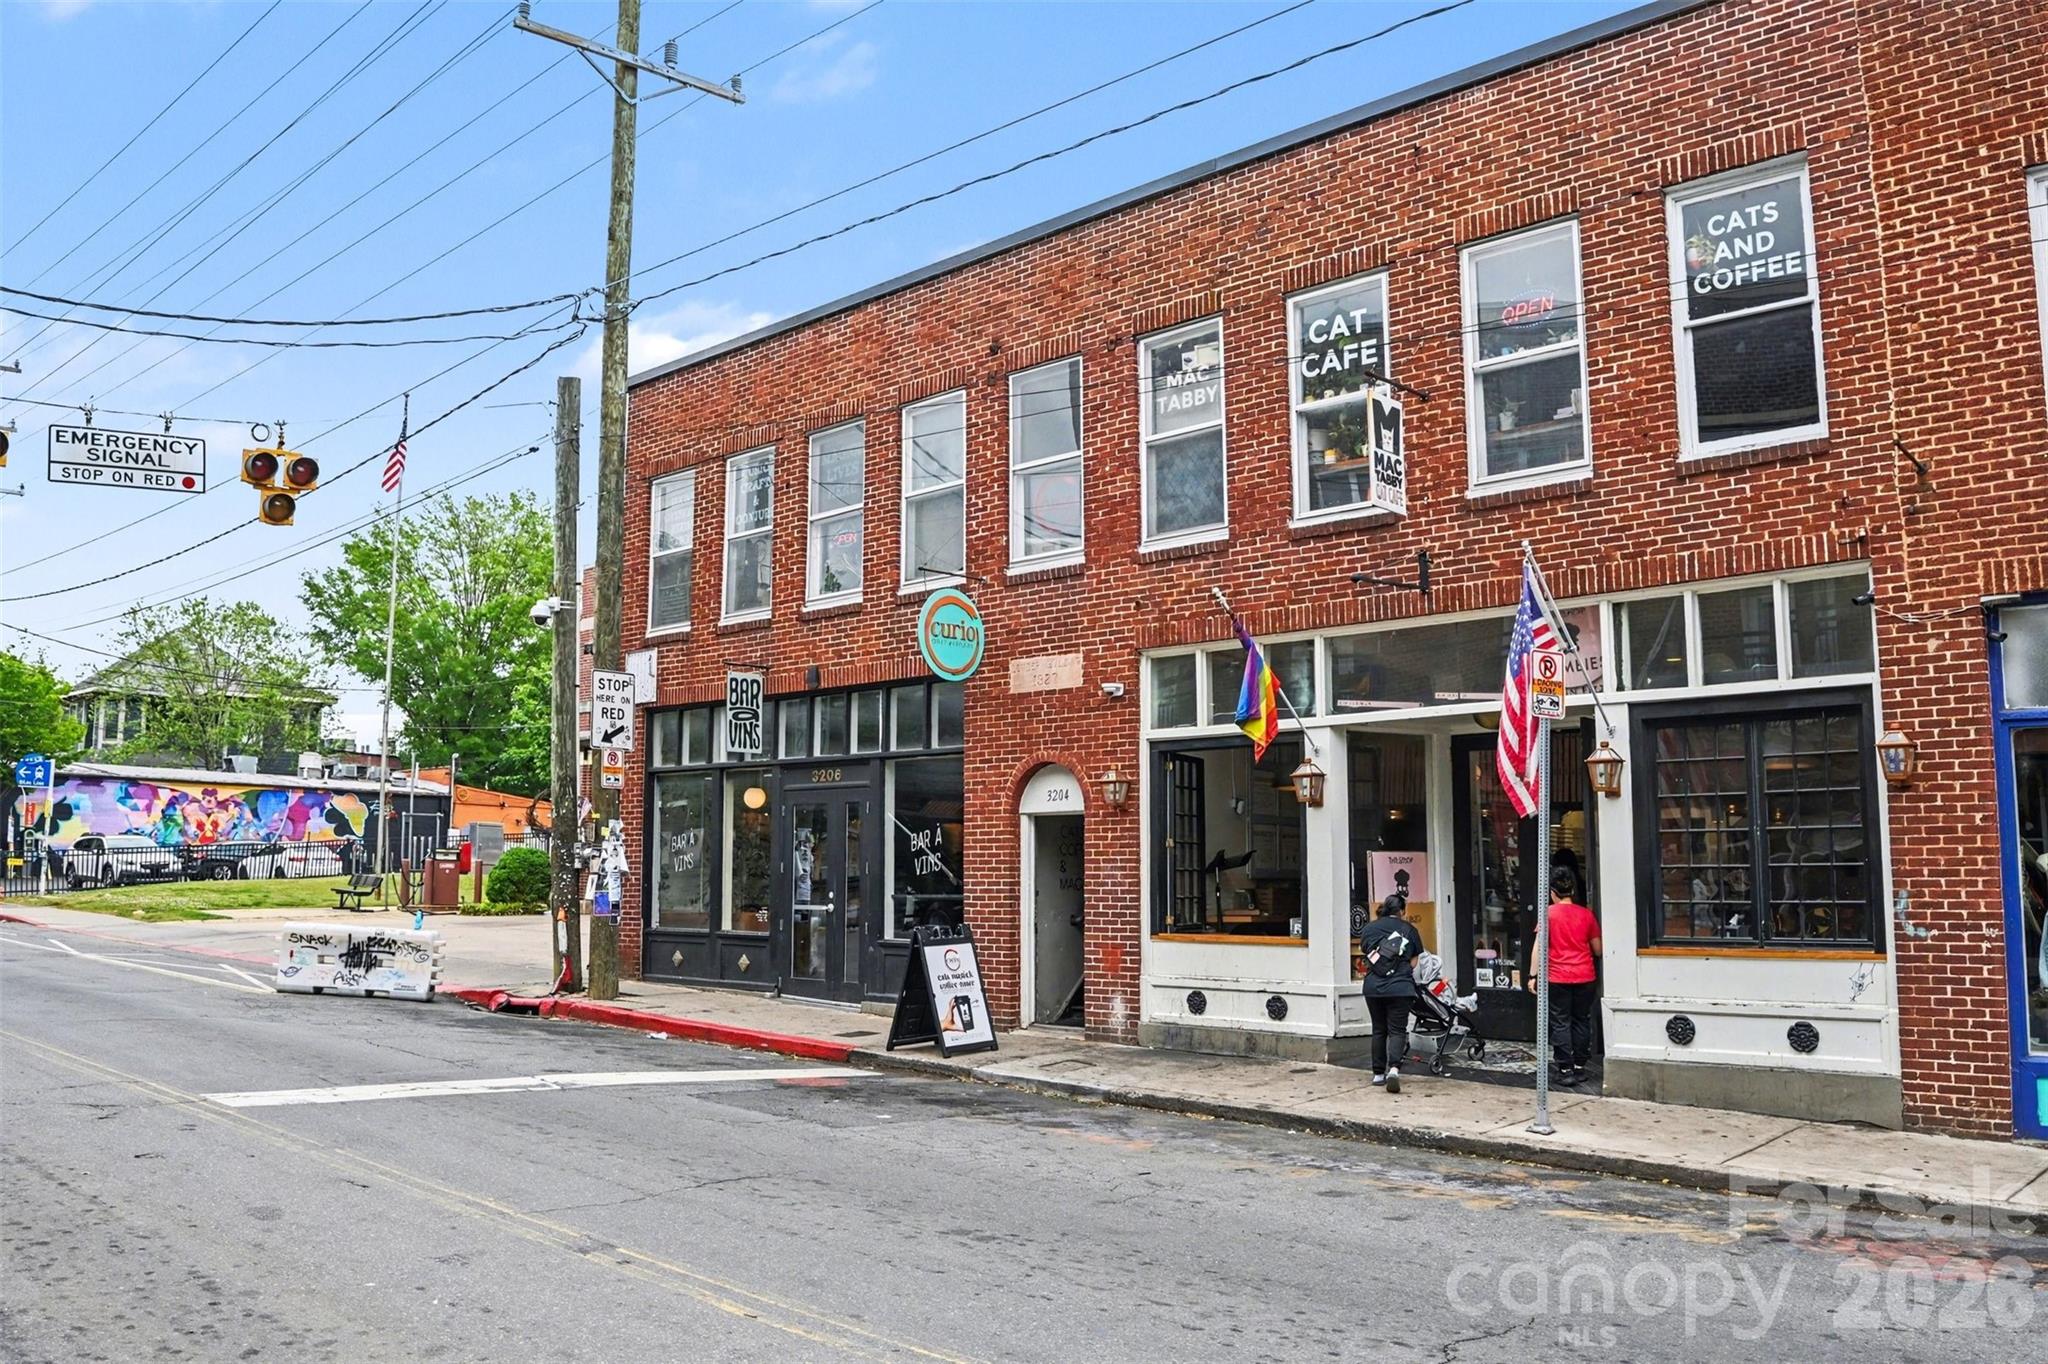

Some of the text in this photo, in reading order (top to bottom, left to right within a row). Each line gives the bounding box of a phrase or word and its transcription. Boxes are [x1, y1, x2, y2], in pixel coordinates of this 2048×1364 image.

[1707, 201, 1779, 236] CATS
[1713, 231, 1775, 264] AND
[1694, 251, 1802, 294] COFFEE
[1502, 292, 1554, 325] OPEN
[1309, 308, 1367, 344] CAT
[1301, 338, 1378, 378] CAFE
[1166, 368, 1210, 388] MAC
[1157, 384, 1218, 415] TABBY
[55, 429, 198, 455] EMERGENCY
[86, 448, 171, 468] SIGNAL
[1374, 450, 1403, 477] MAC
[61, 466, 176, 487] STOP ON RED
[1375, 469, 1403, 490] TABBY
[930, 620, 976, 643] curio
[598, 678, 629, 692] STOP
[729, 677, 761, 710] BAR
[596, 694, 631, 705] HERE ON
[601, 707, 625, 721] RED
[728, 719, 761, 750] VINS
[811, 769, 841, 783] 3206
[1046, 788, 1070, 802] 3204
[671, 833, 687, 853] BAR
[911, 829, 931, 852] BAR
[674, 852, 694, 873] VINS
[914, 852, 942, 876] VINS
